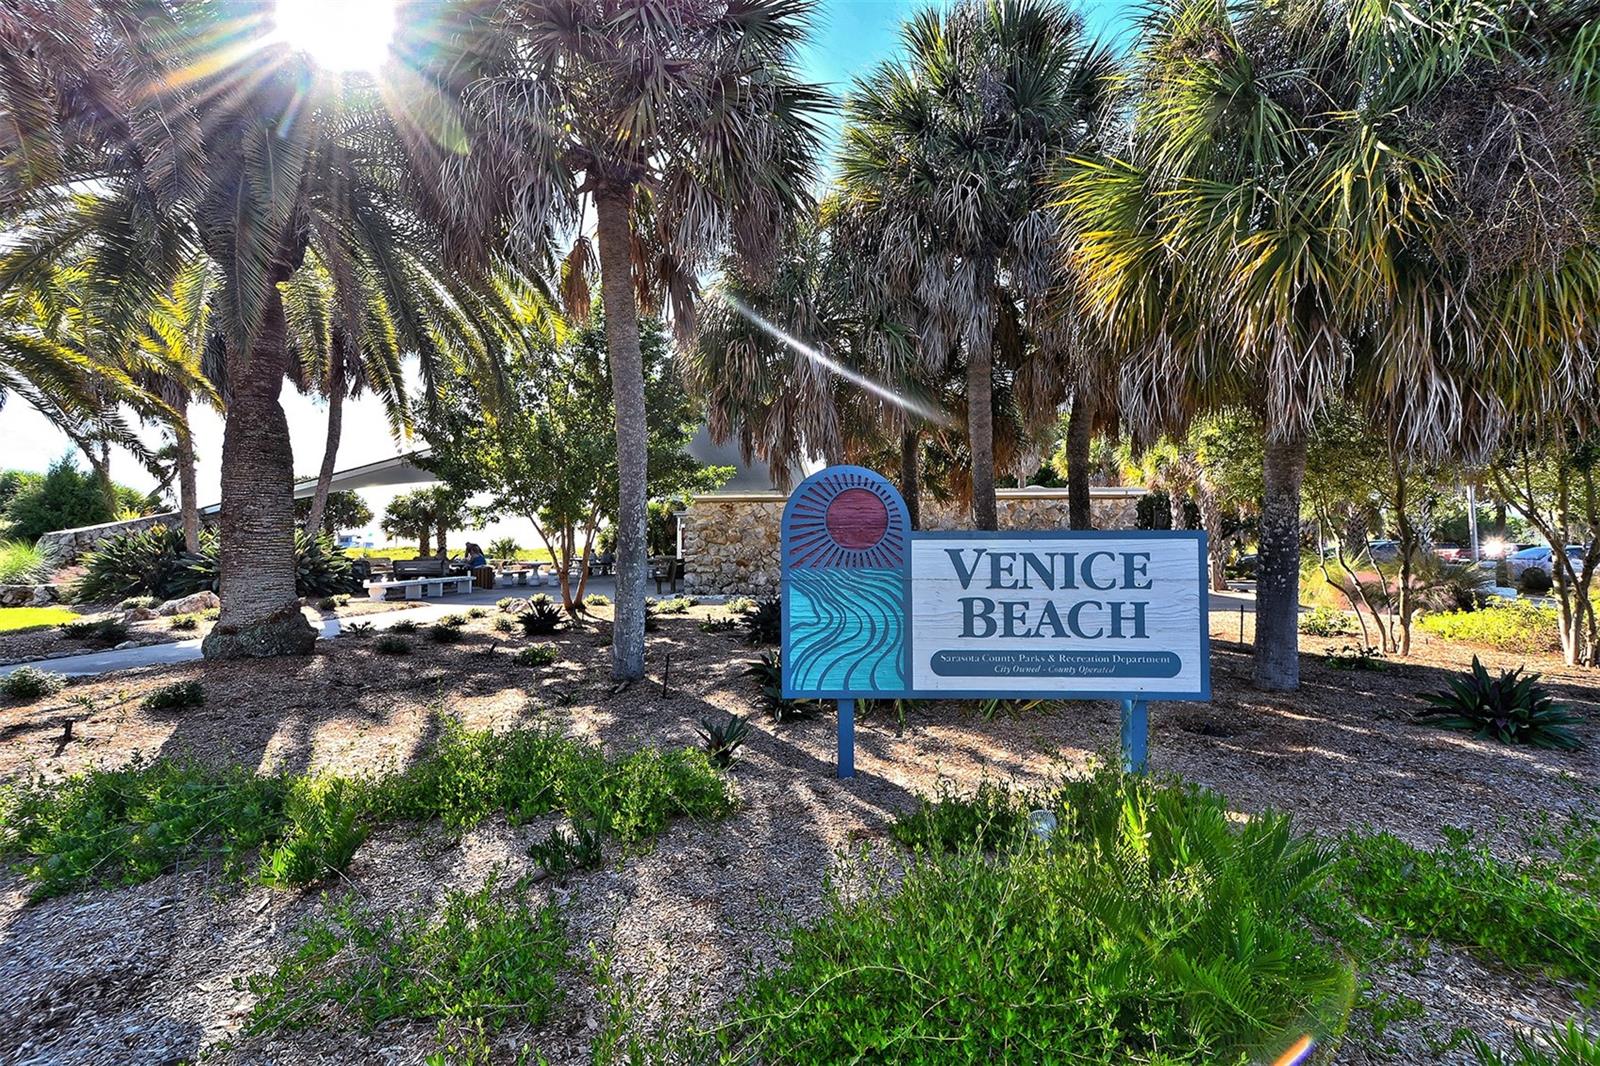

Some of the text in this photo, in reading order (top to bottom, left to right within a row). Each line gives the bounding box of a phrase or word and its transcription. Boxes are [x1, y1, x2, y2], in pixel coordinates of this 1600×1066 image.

[944, 548, 1153, 591] VENICE
[958, 596, 1150, 639] BEACH
[940, 654, 1171, 665] Sarasota County Parks & Recreation Department
[994, 665, 1011, 674] City
[1012, 665, 1041, 673] Owned
[1048, 665, 1077, 675] County
[1078, 665, 1115, 675] Operated
